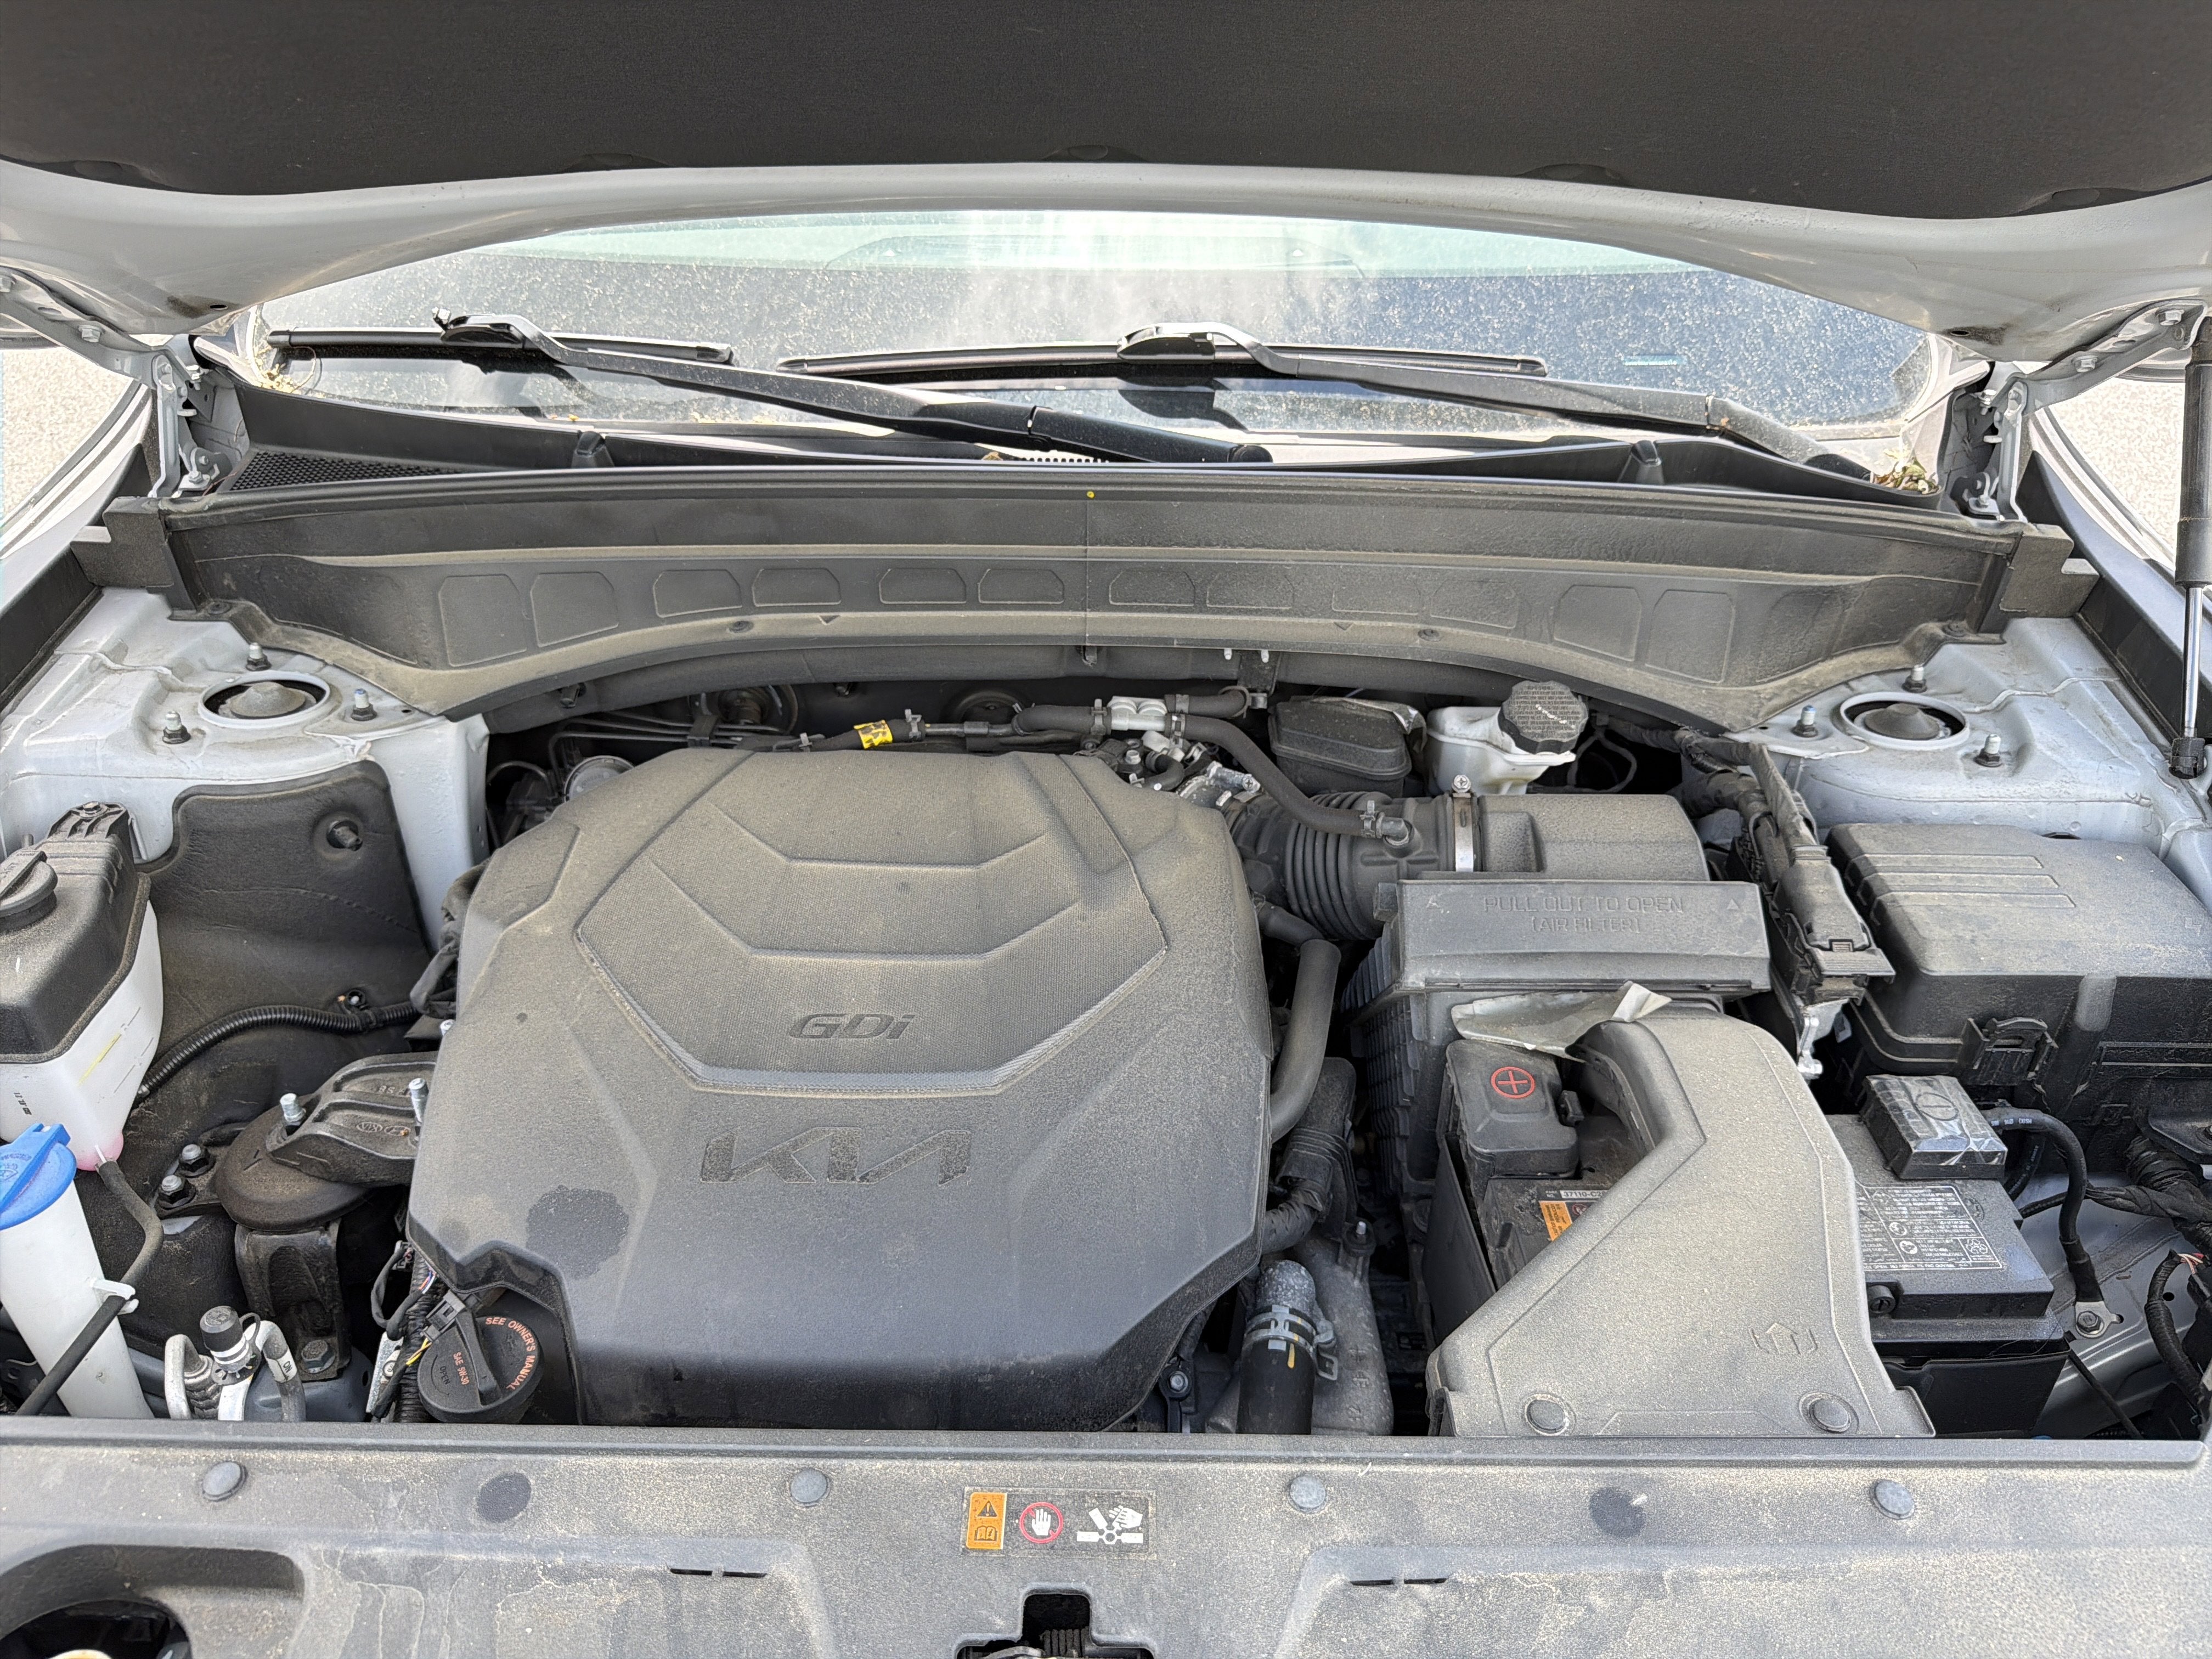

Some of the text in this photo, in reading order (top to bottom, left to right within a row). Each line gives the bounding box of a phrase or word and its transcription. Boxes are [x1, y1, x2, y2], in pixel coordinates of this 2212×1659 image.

[1483, 895, 1684, 913] PULL OUT TO OPEN
[485, 1317, 536, 1390] SEE OWNER'S MANUAL
[439, 1365, 450, 1385] OPEN
[453, 1352, 470, 1385] SAE 5W-30
